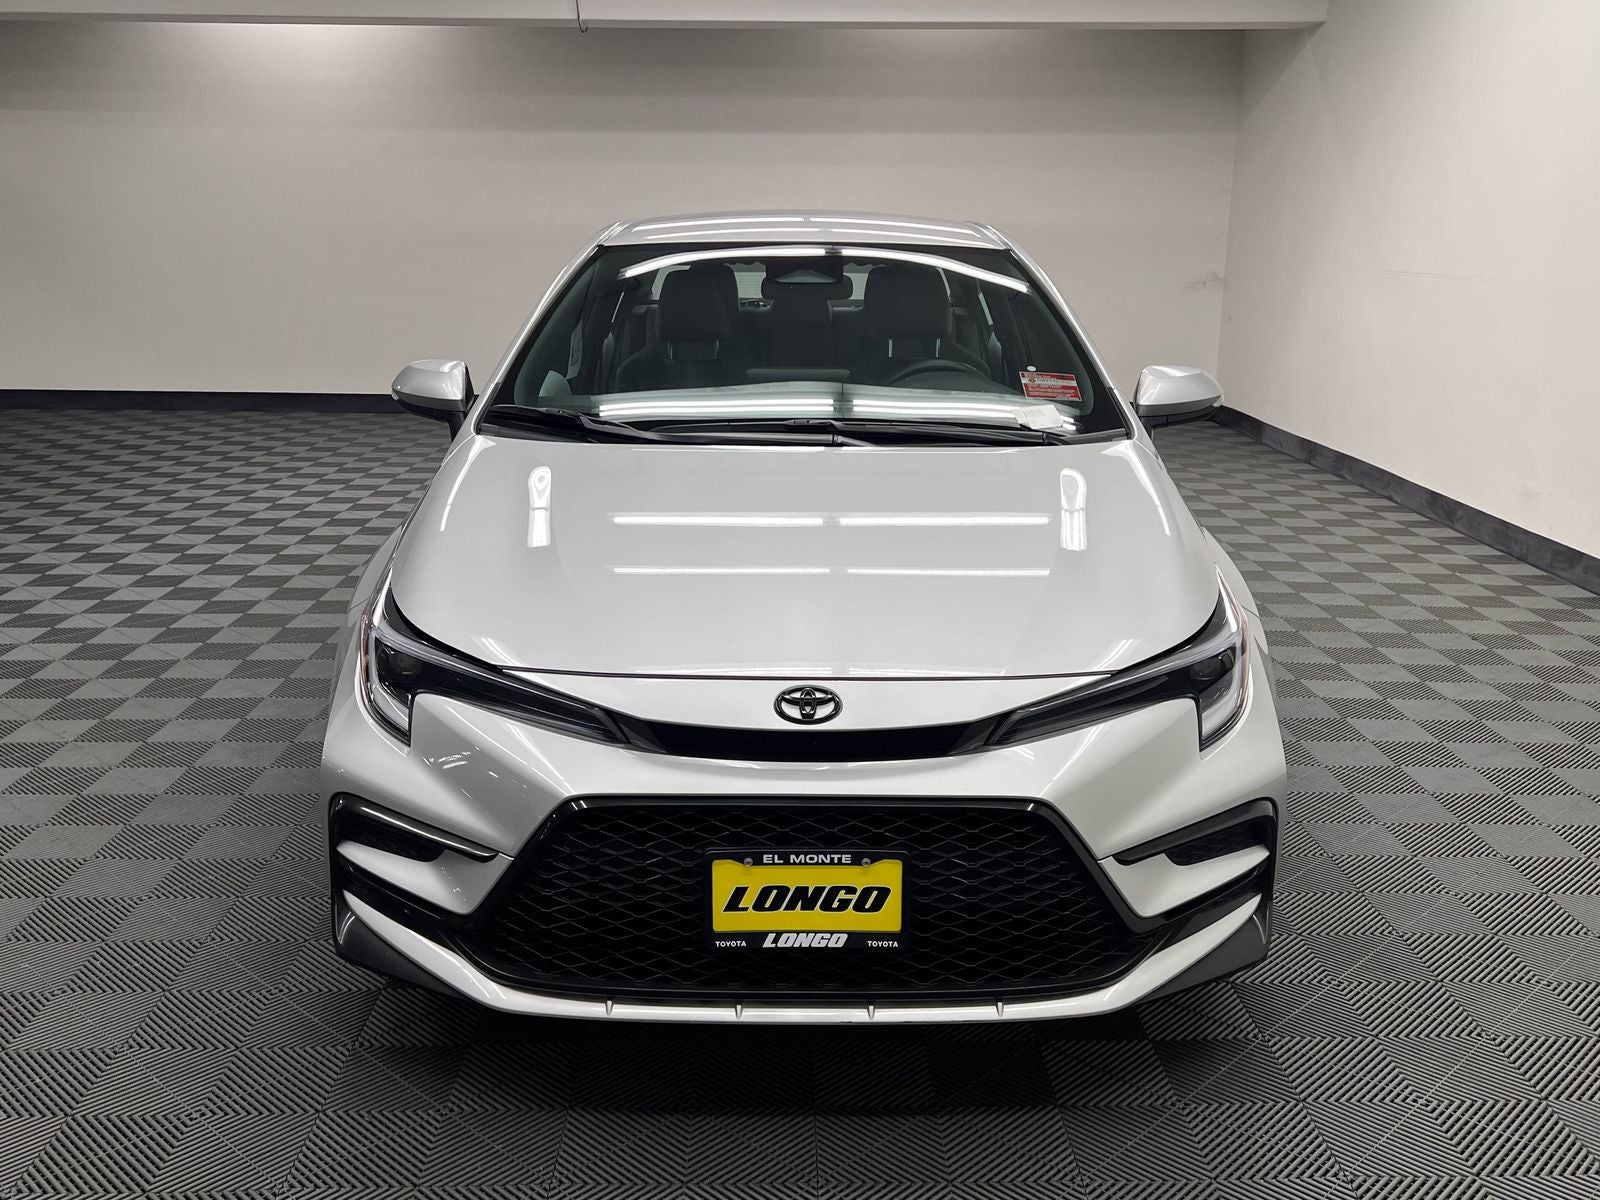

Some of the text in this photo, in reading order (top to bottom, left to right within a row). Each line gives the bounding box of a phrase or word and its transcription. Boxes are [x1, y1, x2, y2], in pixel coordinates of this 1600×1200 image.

[762, 854, 852, 864] EL MONTE
[722, 884, 892, 914] LONGO
[715, 940, 747, 948] TOYOTA
[762, 933, 848, 948] LONGO
[867, 940, 899, 948] TOYOTA
